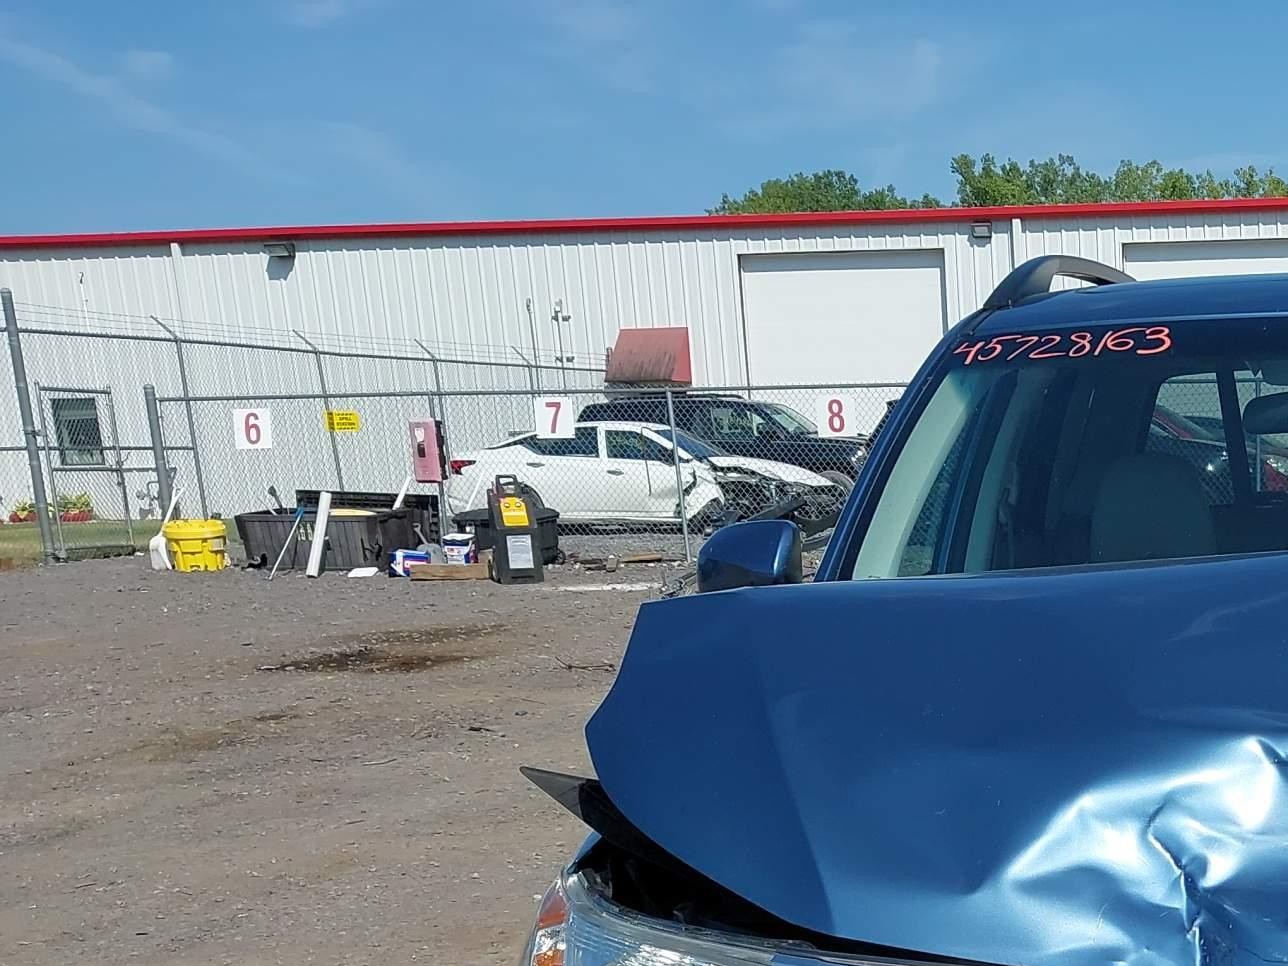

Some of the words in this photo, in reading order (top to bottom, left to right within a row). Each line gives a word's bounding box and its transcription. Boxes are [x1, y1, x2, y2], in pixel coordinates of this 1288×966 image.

[953, 326, 1173, 366] 45728163
[244, 412, 262, 445] 6
[544, 401, 562, 434] 7
[827, 398, 846, 433] 8
